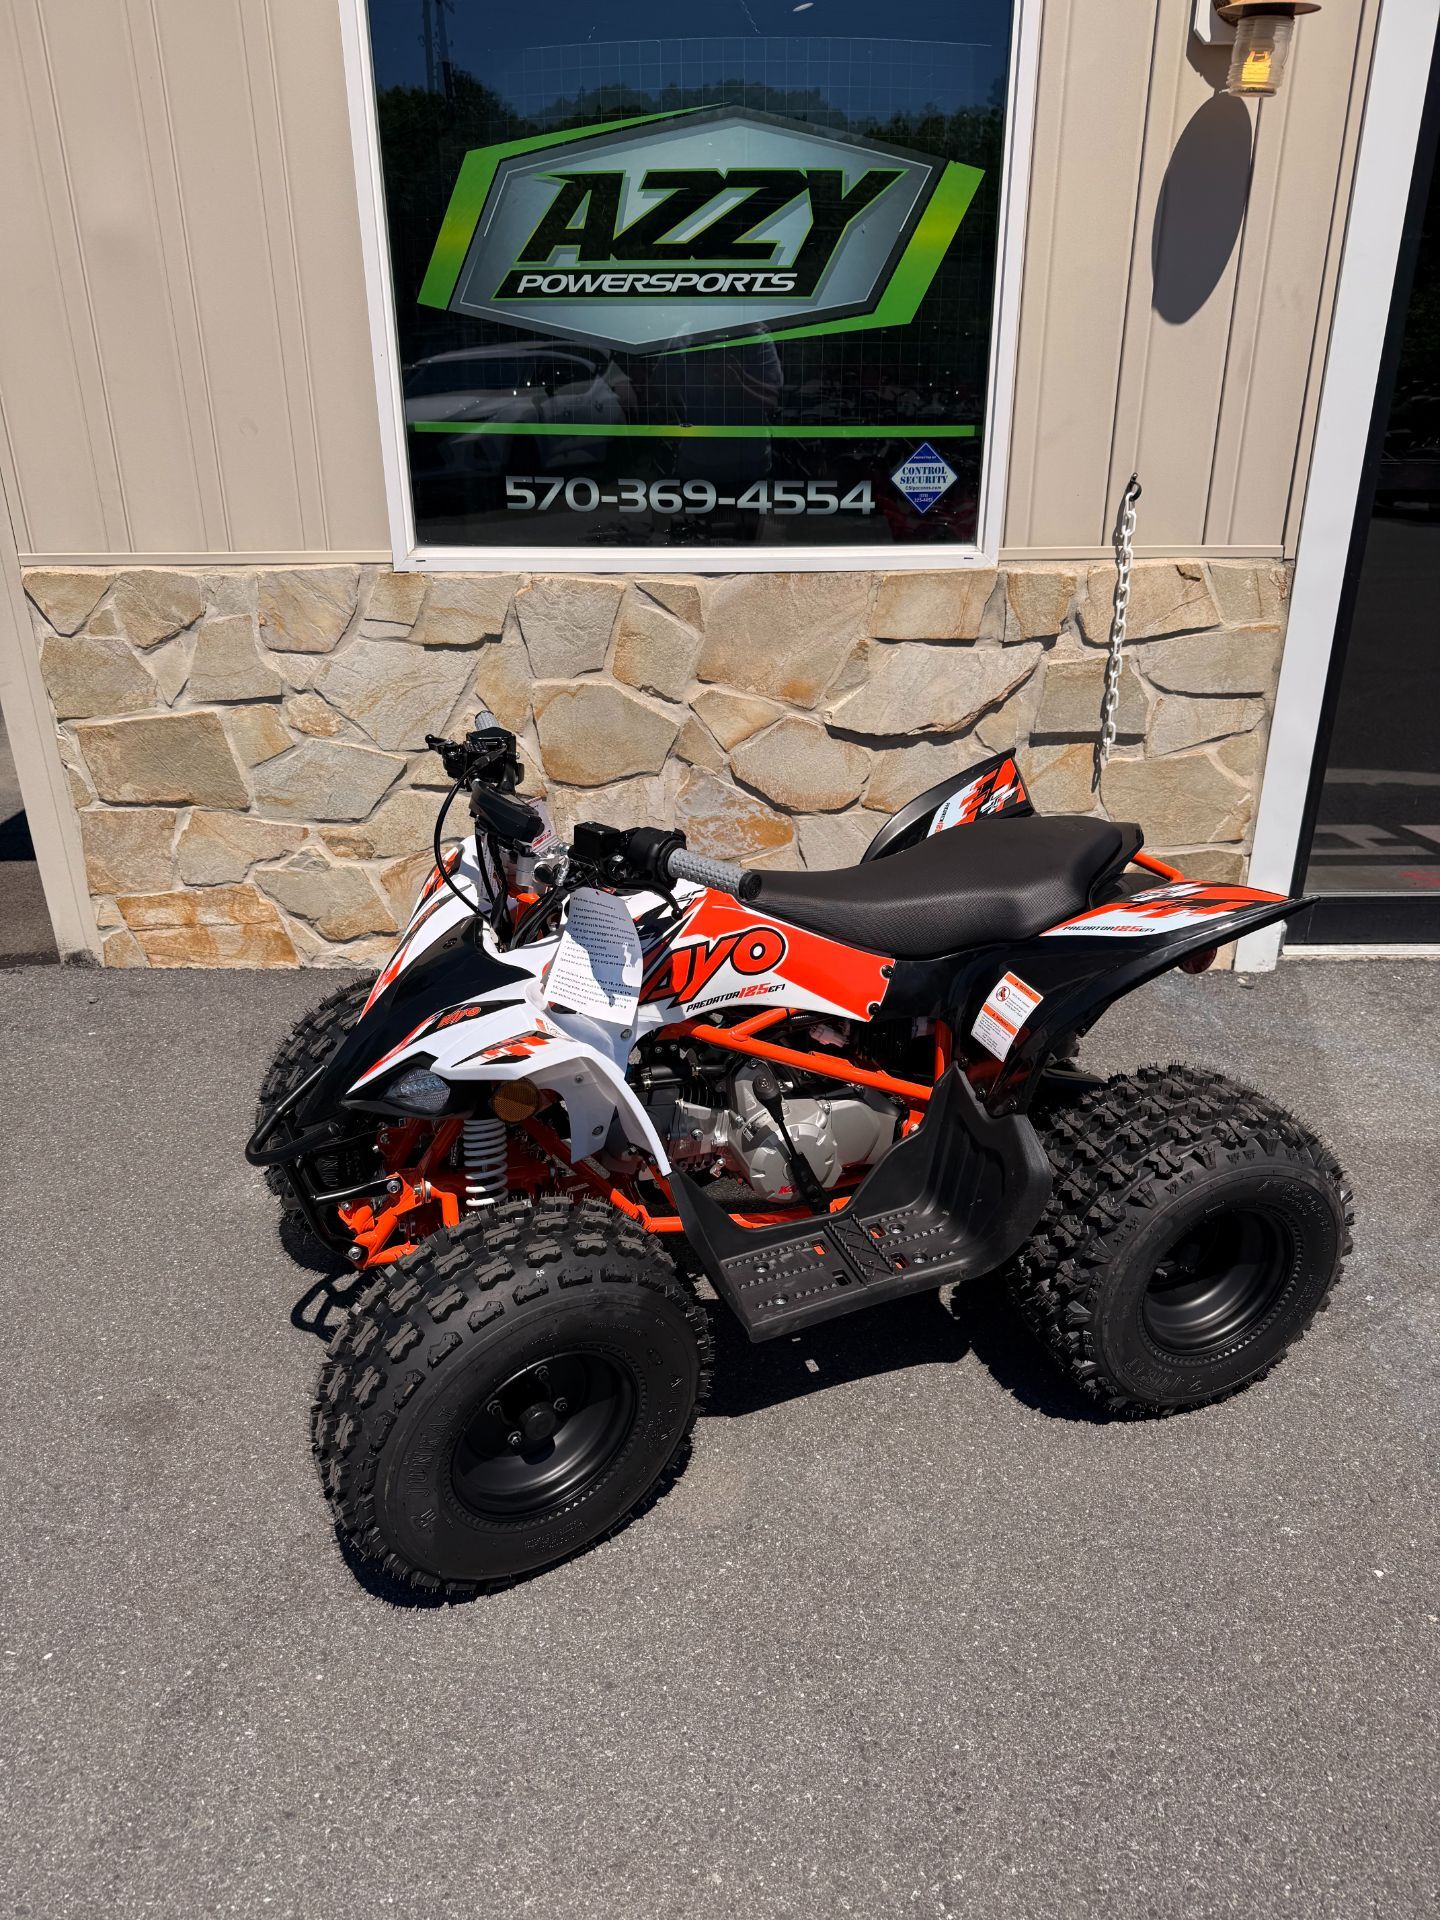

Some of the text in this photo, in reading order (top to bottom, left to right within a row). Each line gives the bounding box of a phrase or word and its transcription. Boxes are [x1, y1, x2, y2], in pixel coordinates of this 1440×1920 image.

[513, 168, 909, 266] AZZY
[516, 272, 798, 294] POWERSPORTS
[900, 475, 948, 485] SECURITY
[902, 466, 947, 475] CONTROL
[505, 475, 876, 515] 570-369-4554
[638, 926, 787, 1010] AYO
